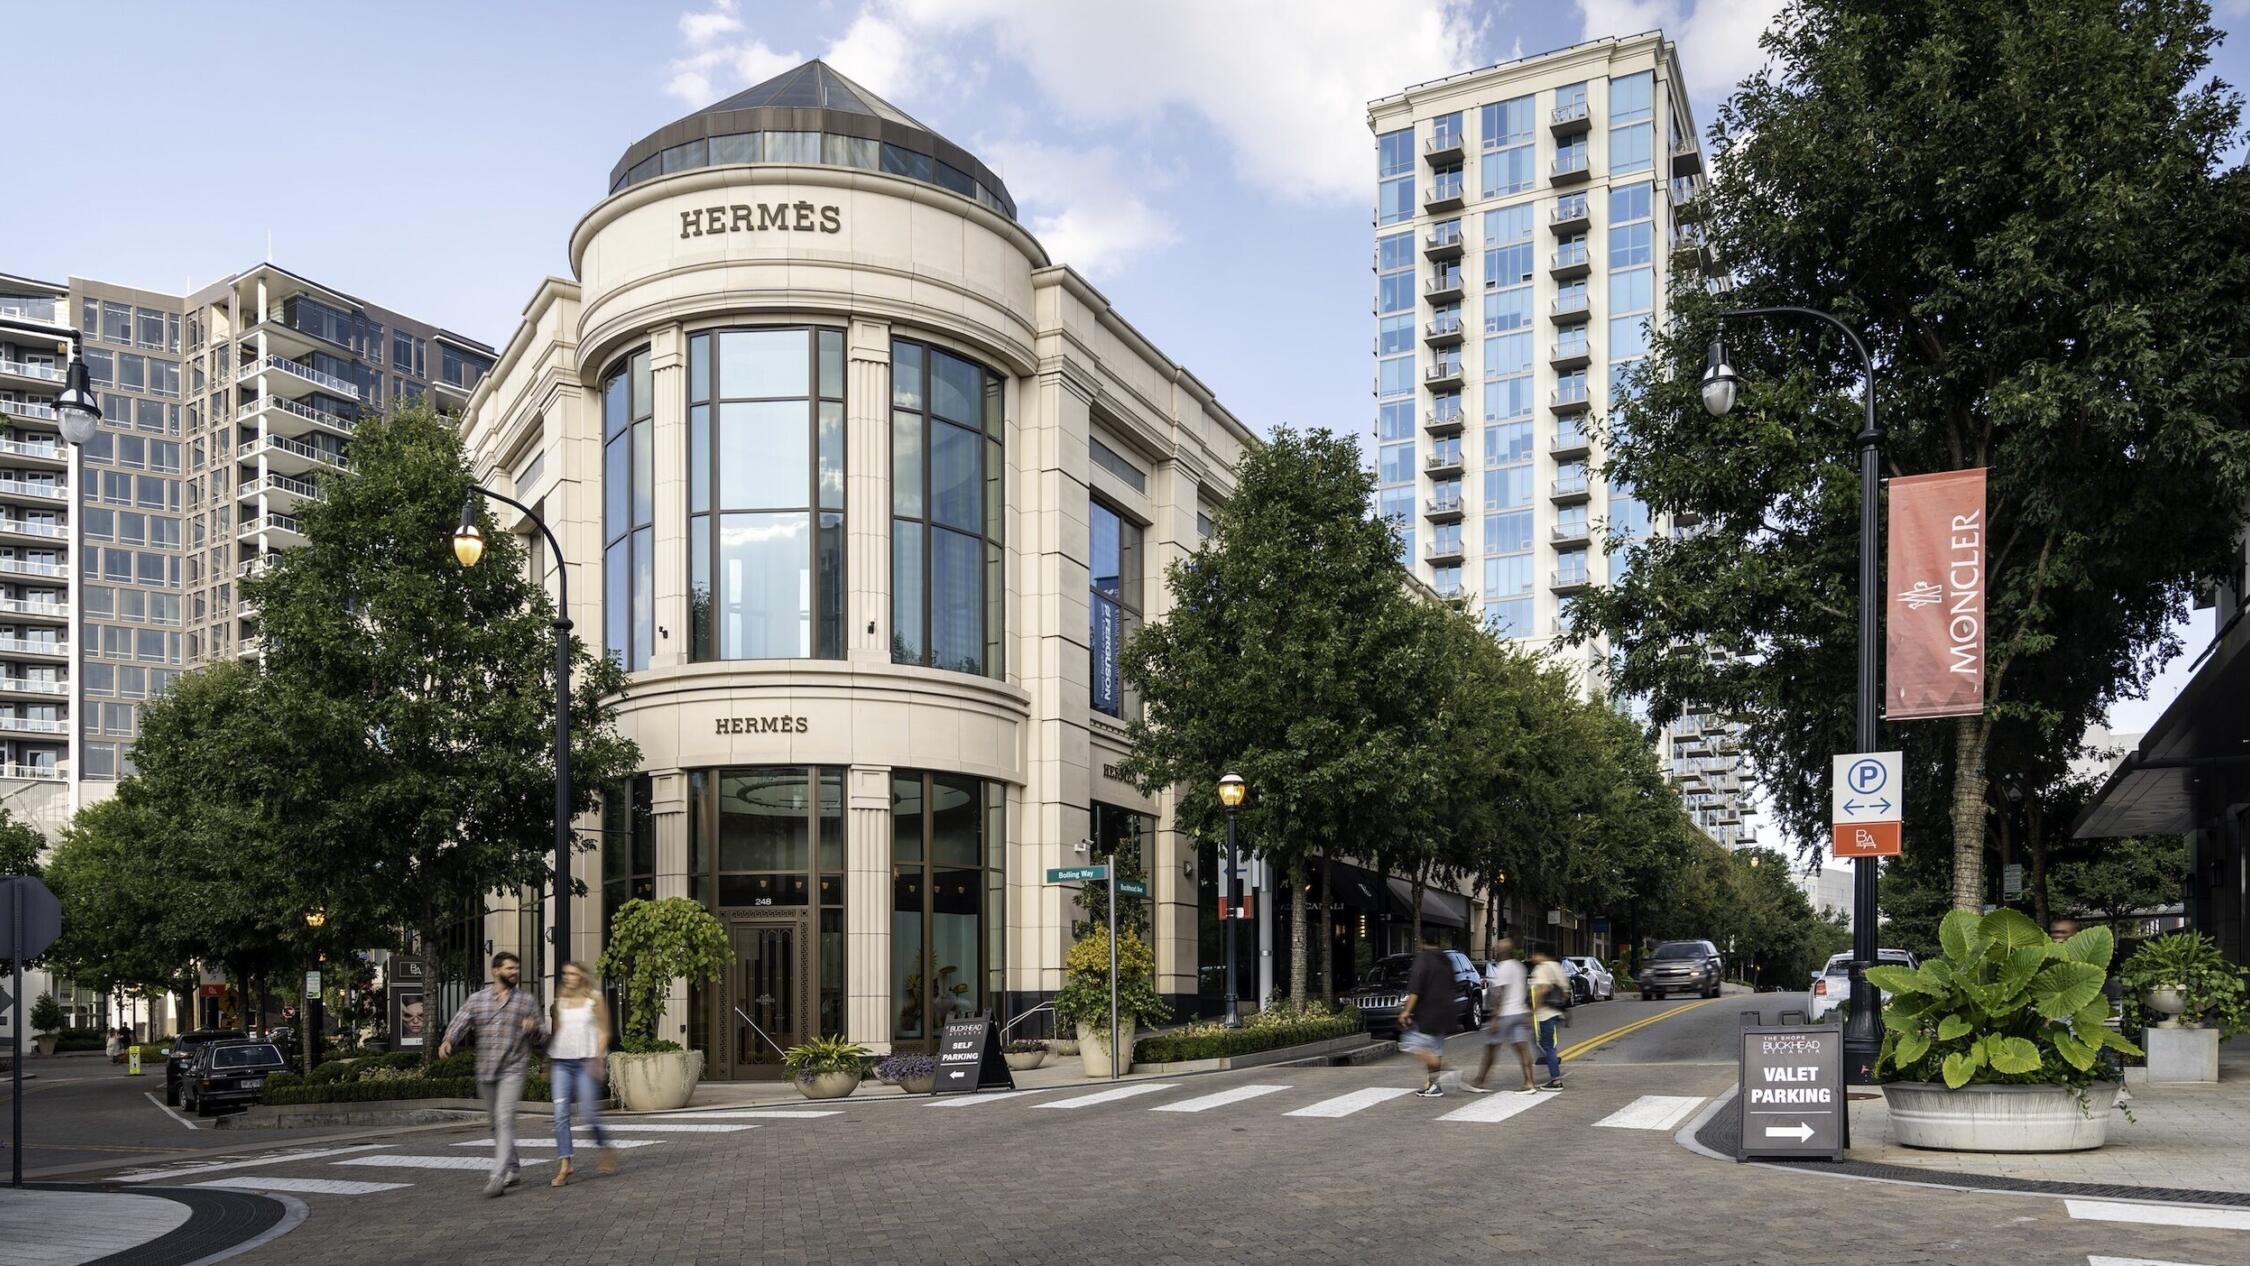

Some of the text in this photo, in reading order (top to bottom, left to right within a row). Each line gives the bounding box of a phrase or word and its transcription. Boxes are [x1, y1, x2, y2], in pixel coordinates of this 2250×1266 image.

[680, 200, 841, 239] HERMÈS
[1949, 509, 1980, 674] MONCLER
[715, 715, 808, 735] HERMÈS
[1859, 766, 1878, 788] P
[1058, 869, 1094, 879] Bolling Way
[755, 898, 772, 906] 248
[949, 1024, 983, 1033] BUCKHEAD
[952, 1041, 974, 1050] SELF
[1763, 1040, 1820, 1050] BUCKHEAD
[942, 1052, 979, 1061] PARKING
[1763, 1066, 1819, 1081] VALET
[1751, 1088, 1831, 1103] PARKING
